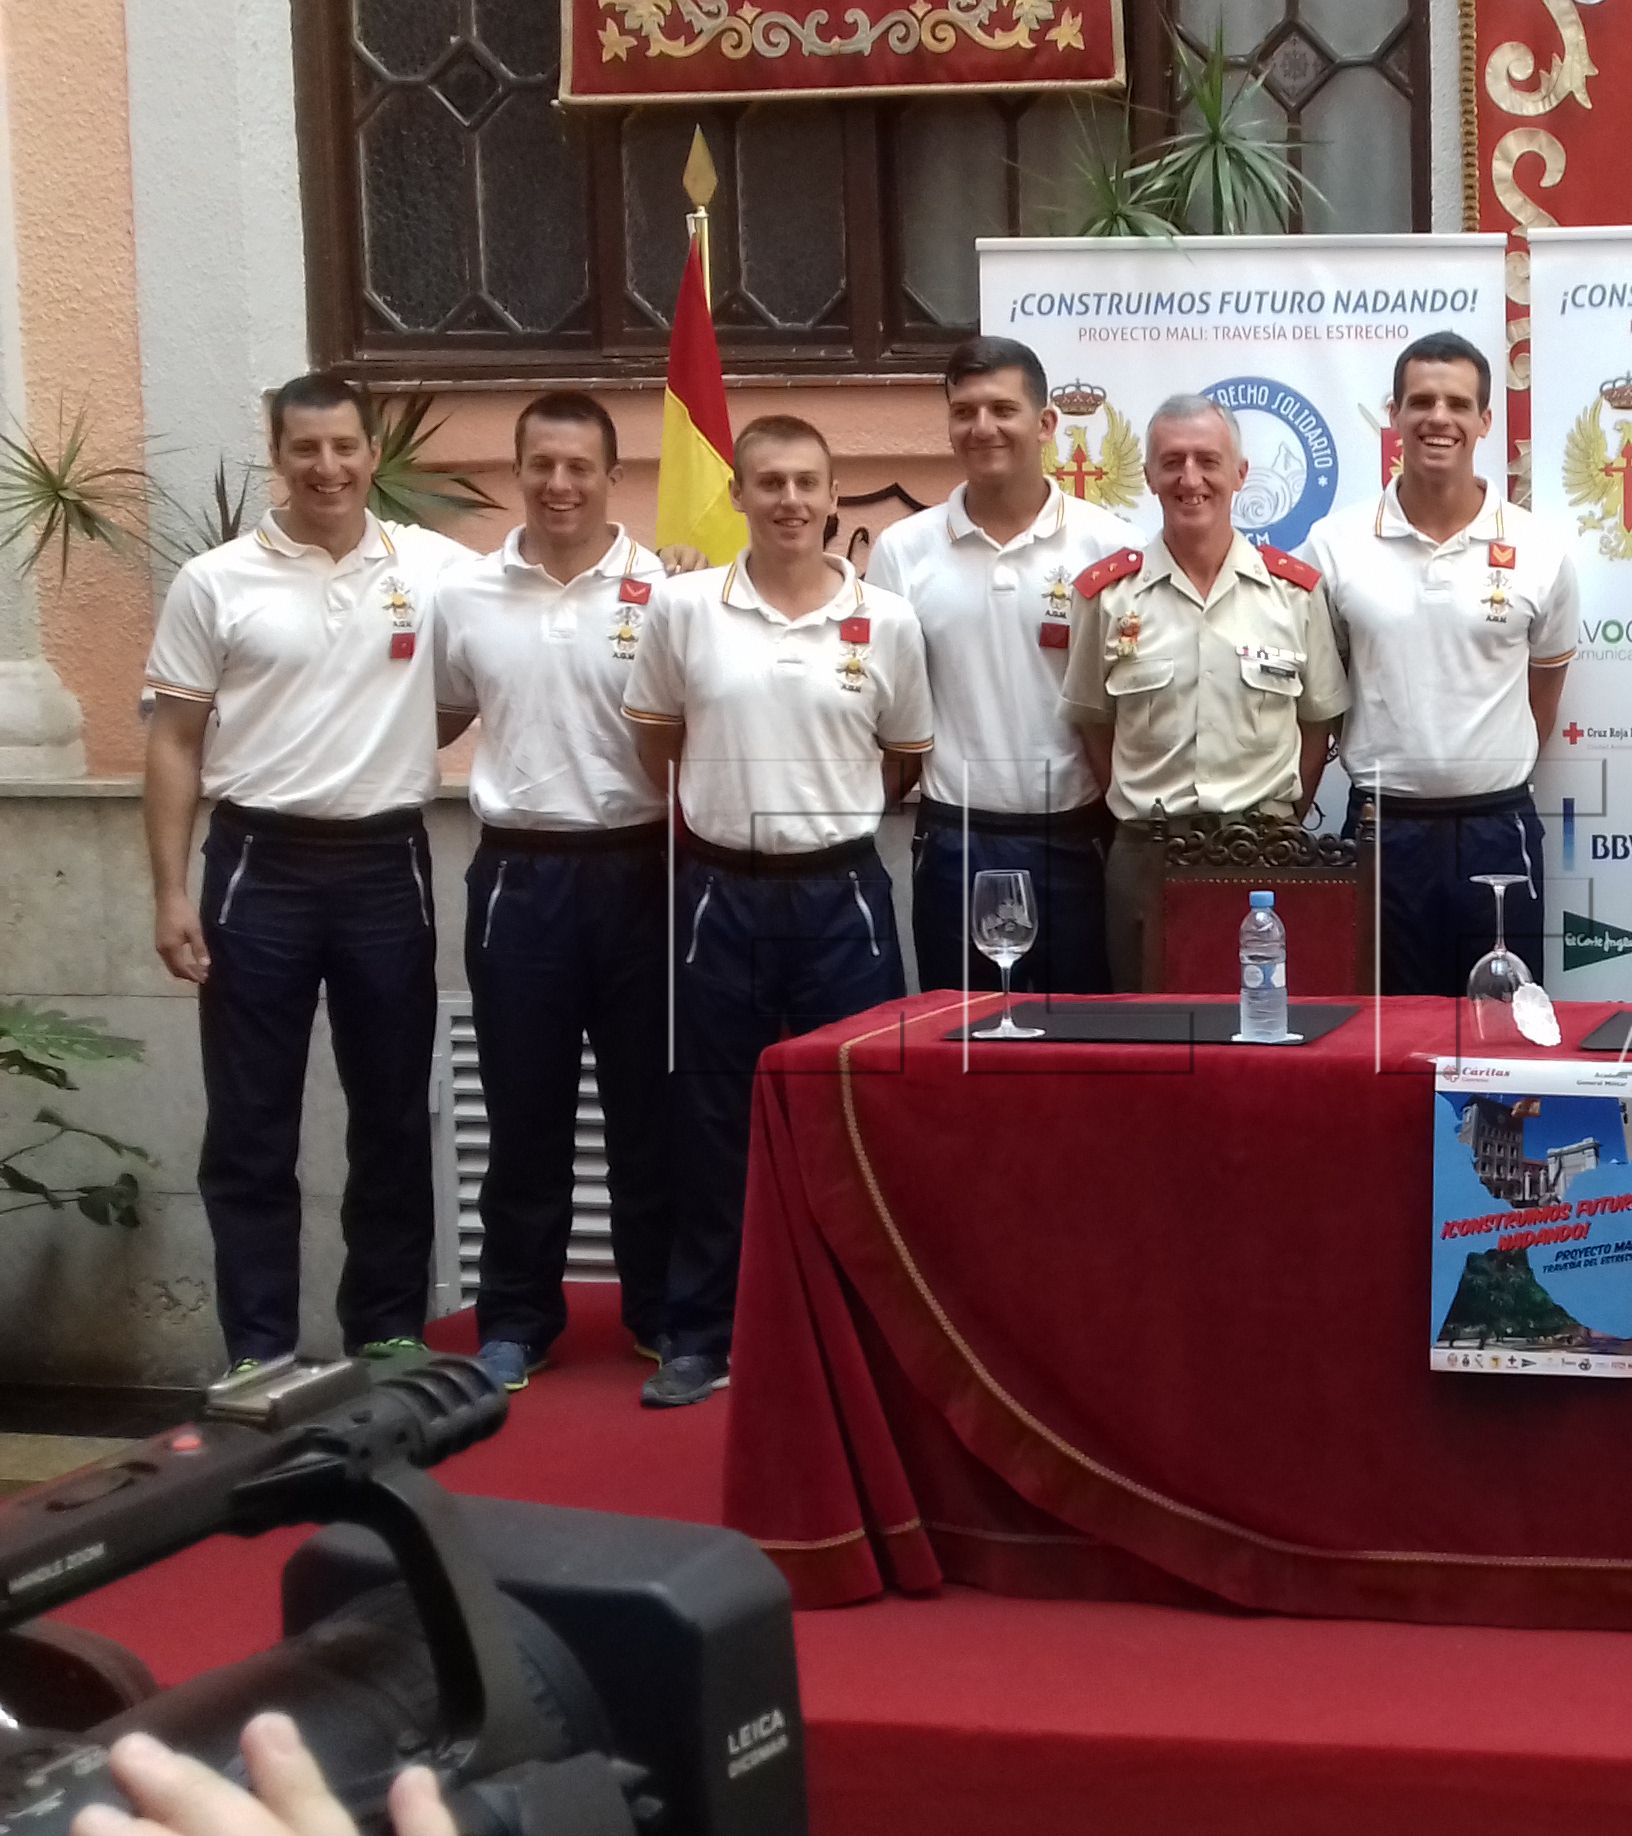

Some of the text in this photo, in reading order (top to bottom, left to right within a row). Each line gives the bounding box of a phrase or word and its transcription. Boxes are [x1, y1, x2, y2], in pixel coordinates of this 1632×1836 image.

[1010, 288, 1479, 322] ¡CONSTRUIMOS FUTURO NADANDO!
[1078, 321, 1409, 342] PROYECTO MALI: TRAVESÍA DEL ESTRECHO
[1271, 391, 1333, 469] SOLIDARIO
[1587, 727, 1607, 738] Cruz
[1609, 727, 1628, 740] Roja
[727, 1709, 785, 1755] LEICA
